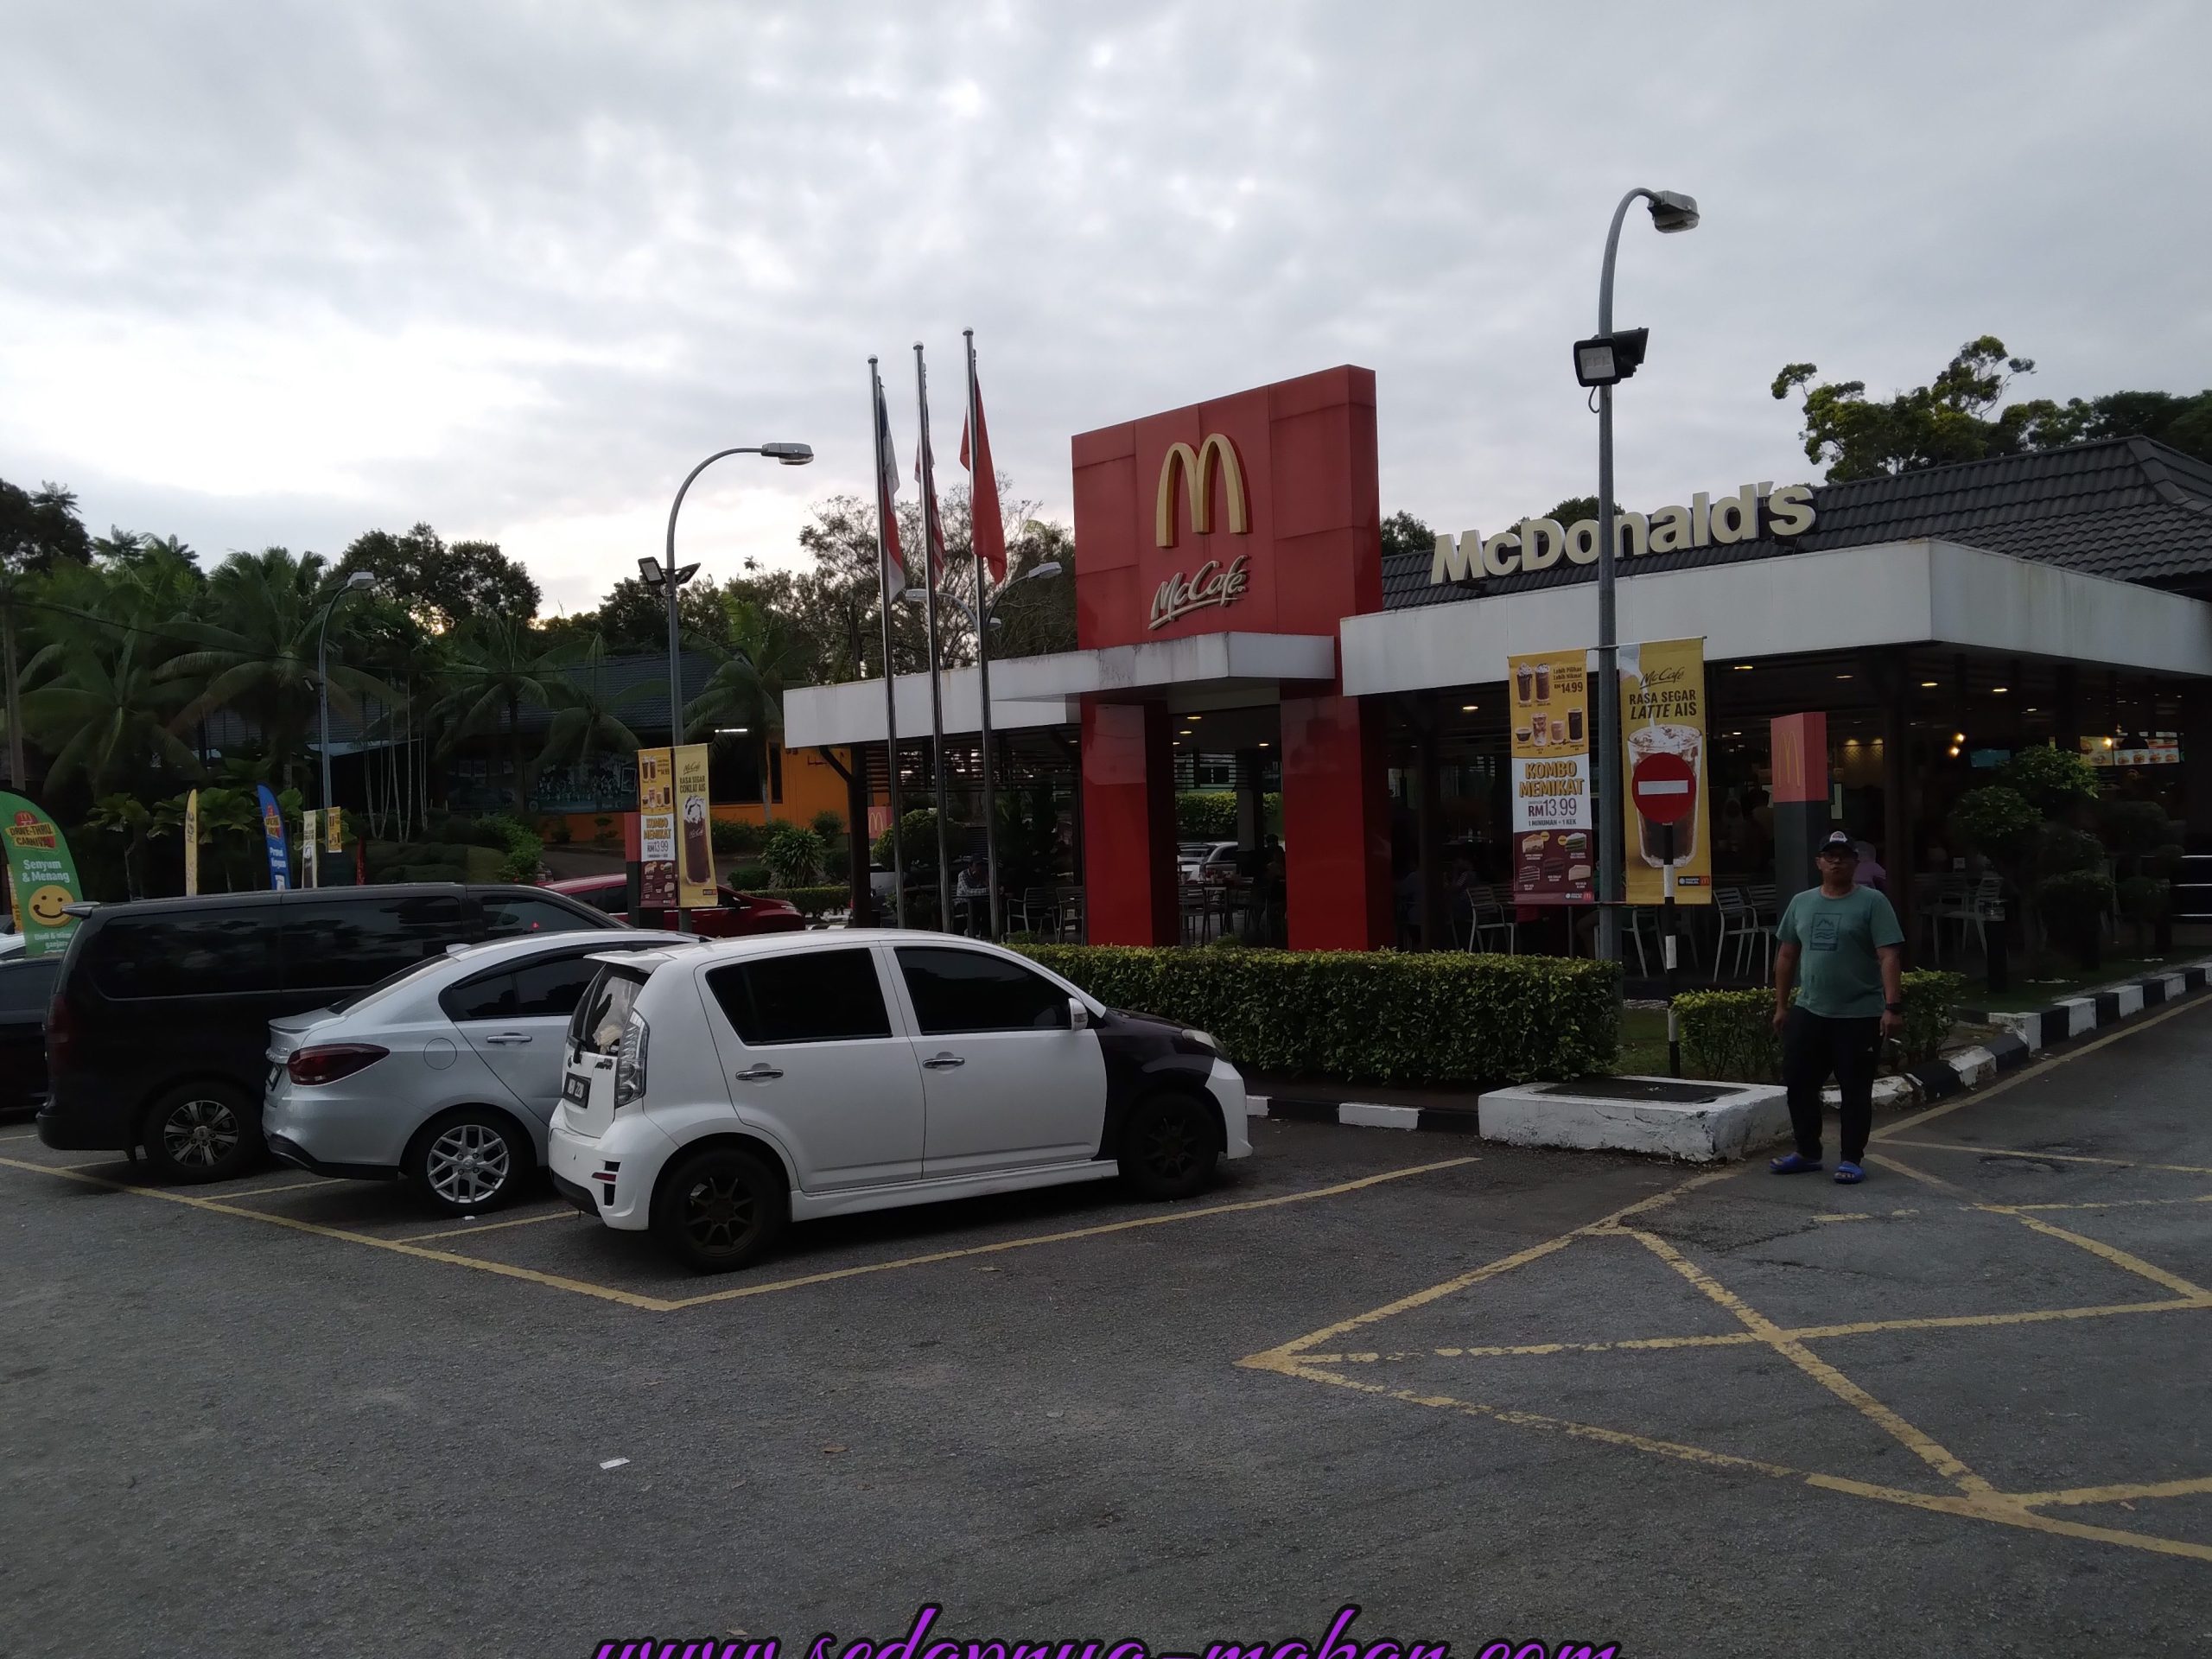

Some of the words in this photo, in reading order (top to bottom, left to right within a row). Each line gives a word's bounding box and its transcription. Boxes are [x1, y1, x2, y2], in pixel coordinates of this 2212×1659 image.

[1430, 480, 1816, 585] McDonald's
[1147, 555, 1249, 629] McCafé
[1629, 692, 1658, 705] RASA
[1661, 690, 1696, 702] SEGAR
[1630, 703, 1671, 720] LATTE
[1675, 702, 1697, 717] AIS
[1525, 760, 1578, 779] KOMBO
[1519, 778, 1585, 798] MEMIKAT
[1528, 798, 1577, 817] RM13.99
[10, 823, 53, 836] DRIVE-THRU
[23, 859, 61, 872] Senyum
[22, 872, 30, 882] &
[32, 871, 70, 883] Menang
